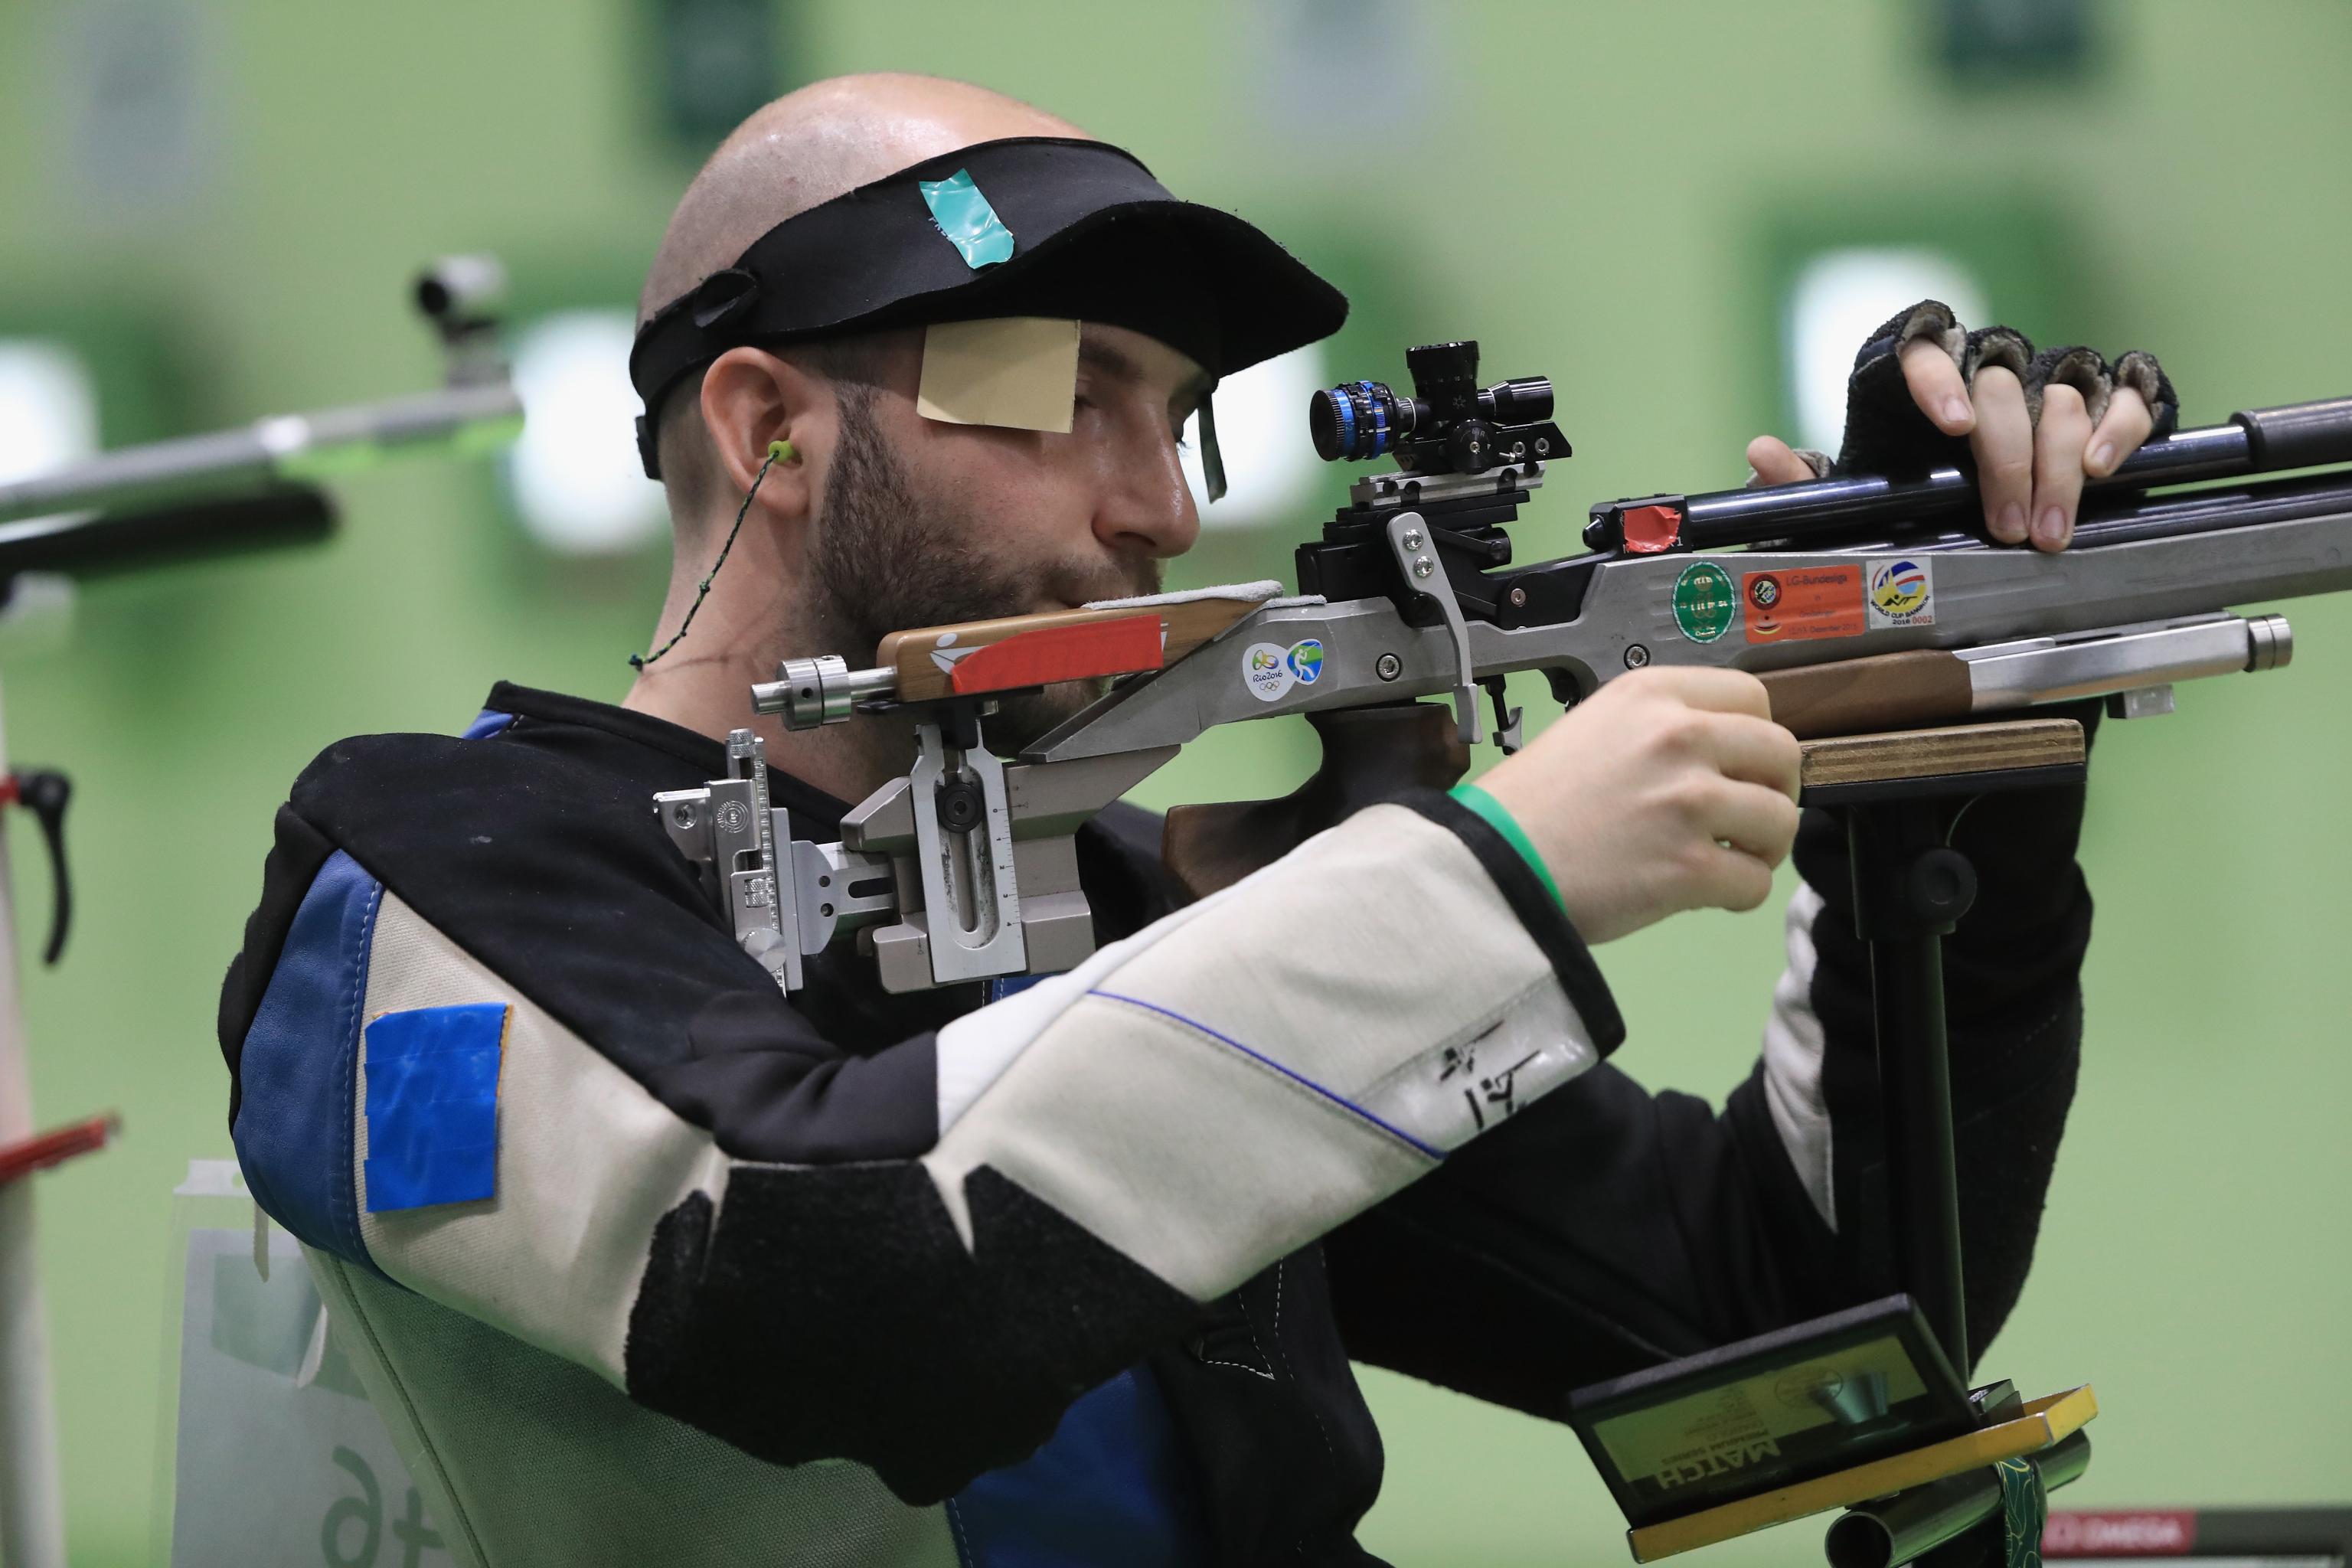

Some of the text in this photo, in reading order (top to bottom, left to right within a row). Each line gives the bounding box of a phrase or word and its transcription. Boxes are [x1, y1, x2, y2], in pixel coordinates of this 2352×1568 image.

[1870, 599, 1890, 616] WORLD
[1906, 594, 1931, 618] BANGKOK
[1913, 615, 1932, 625] 0002
[1655, 1437, 1782, 1490] MATCH
